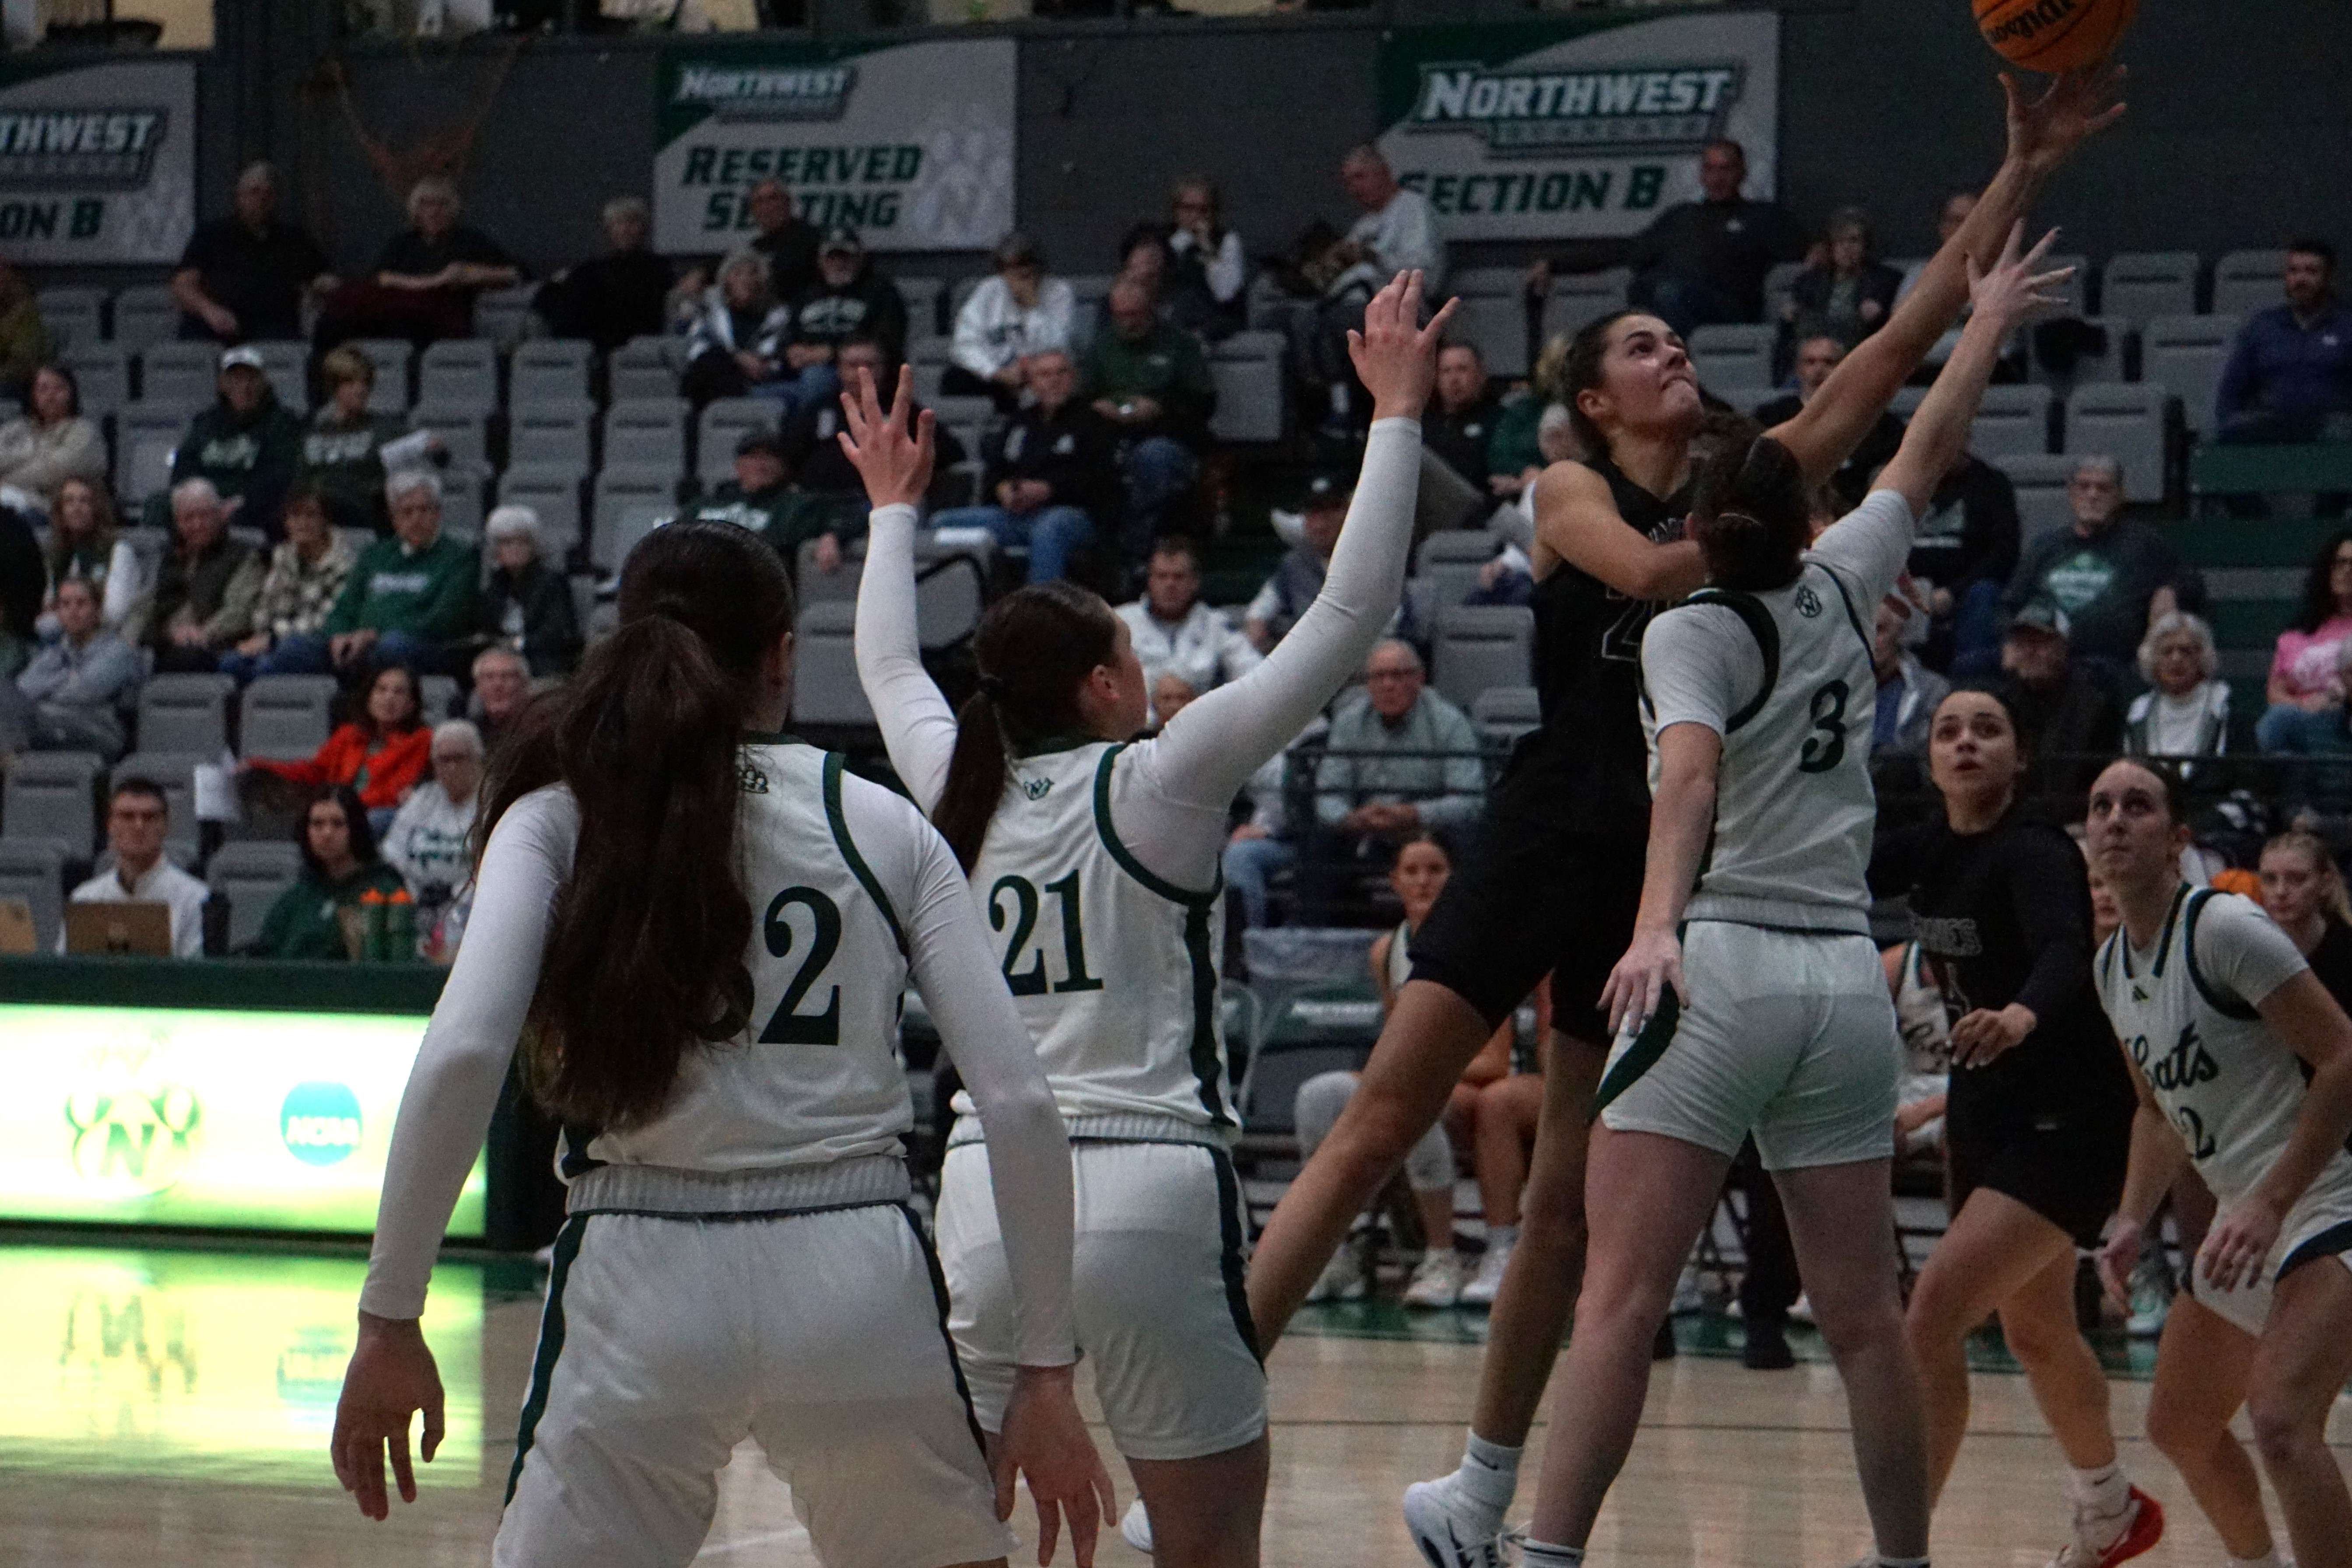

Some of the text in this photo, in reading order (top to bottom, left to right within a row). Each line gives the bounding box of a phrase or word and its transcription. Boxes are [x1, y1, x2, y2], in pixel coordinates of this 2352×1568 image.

[1420, 71, 1732, 119] NORTHWEST
[683, 145, 924, 184] RESERVED
[1623, 165, 1668, 210] B
[69, 199, 105, 238] B
[705, 191, 902, 230] SETING
[1800, 679, 1850, 773] 3
[988, 869, 1103, 996] 21
